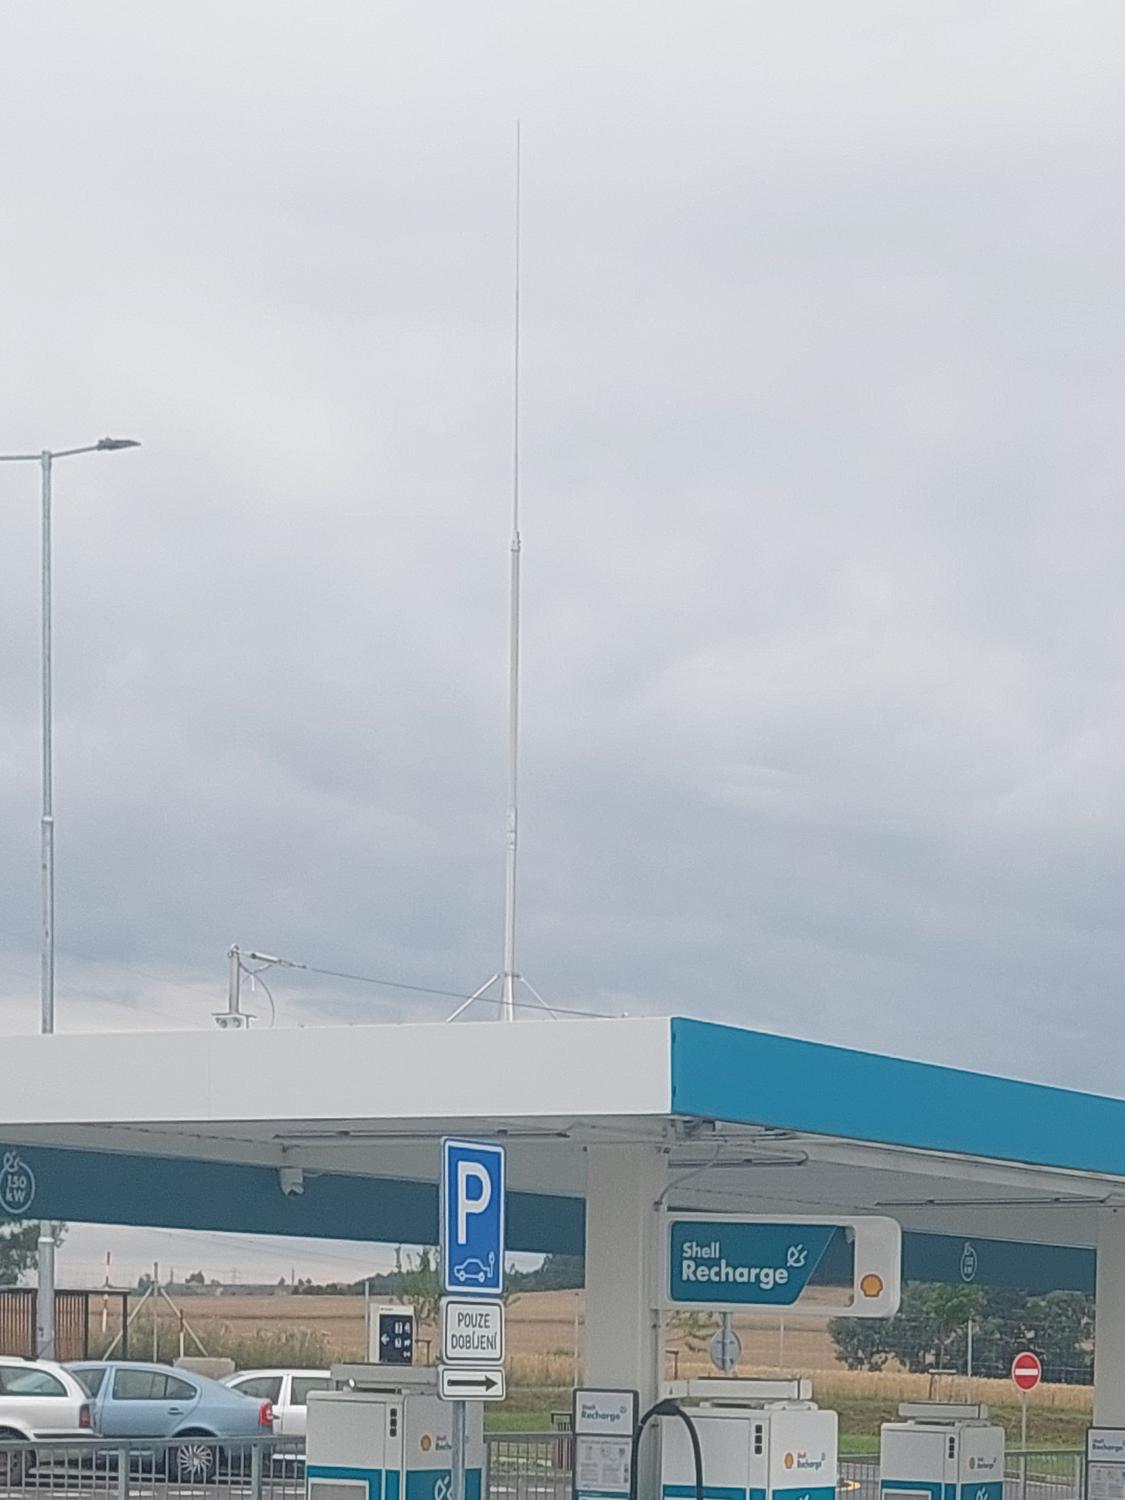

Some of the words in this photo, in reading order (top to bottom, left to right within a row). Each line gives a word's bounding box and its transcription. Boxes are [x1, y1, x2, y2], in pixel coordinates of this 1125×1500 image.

[7, 1174, 27, 1188] 150
[457, 1160, 492, 1245] P
[682, 1241, 720, 1259] Shell
[682, 1259, 789, 1290] Recharge
[457, 1311, 491, 1329] POUZE
[451, 1330, 498, 1350] DOBÍJENÍ
